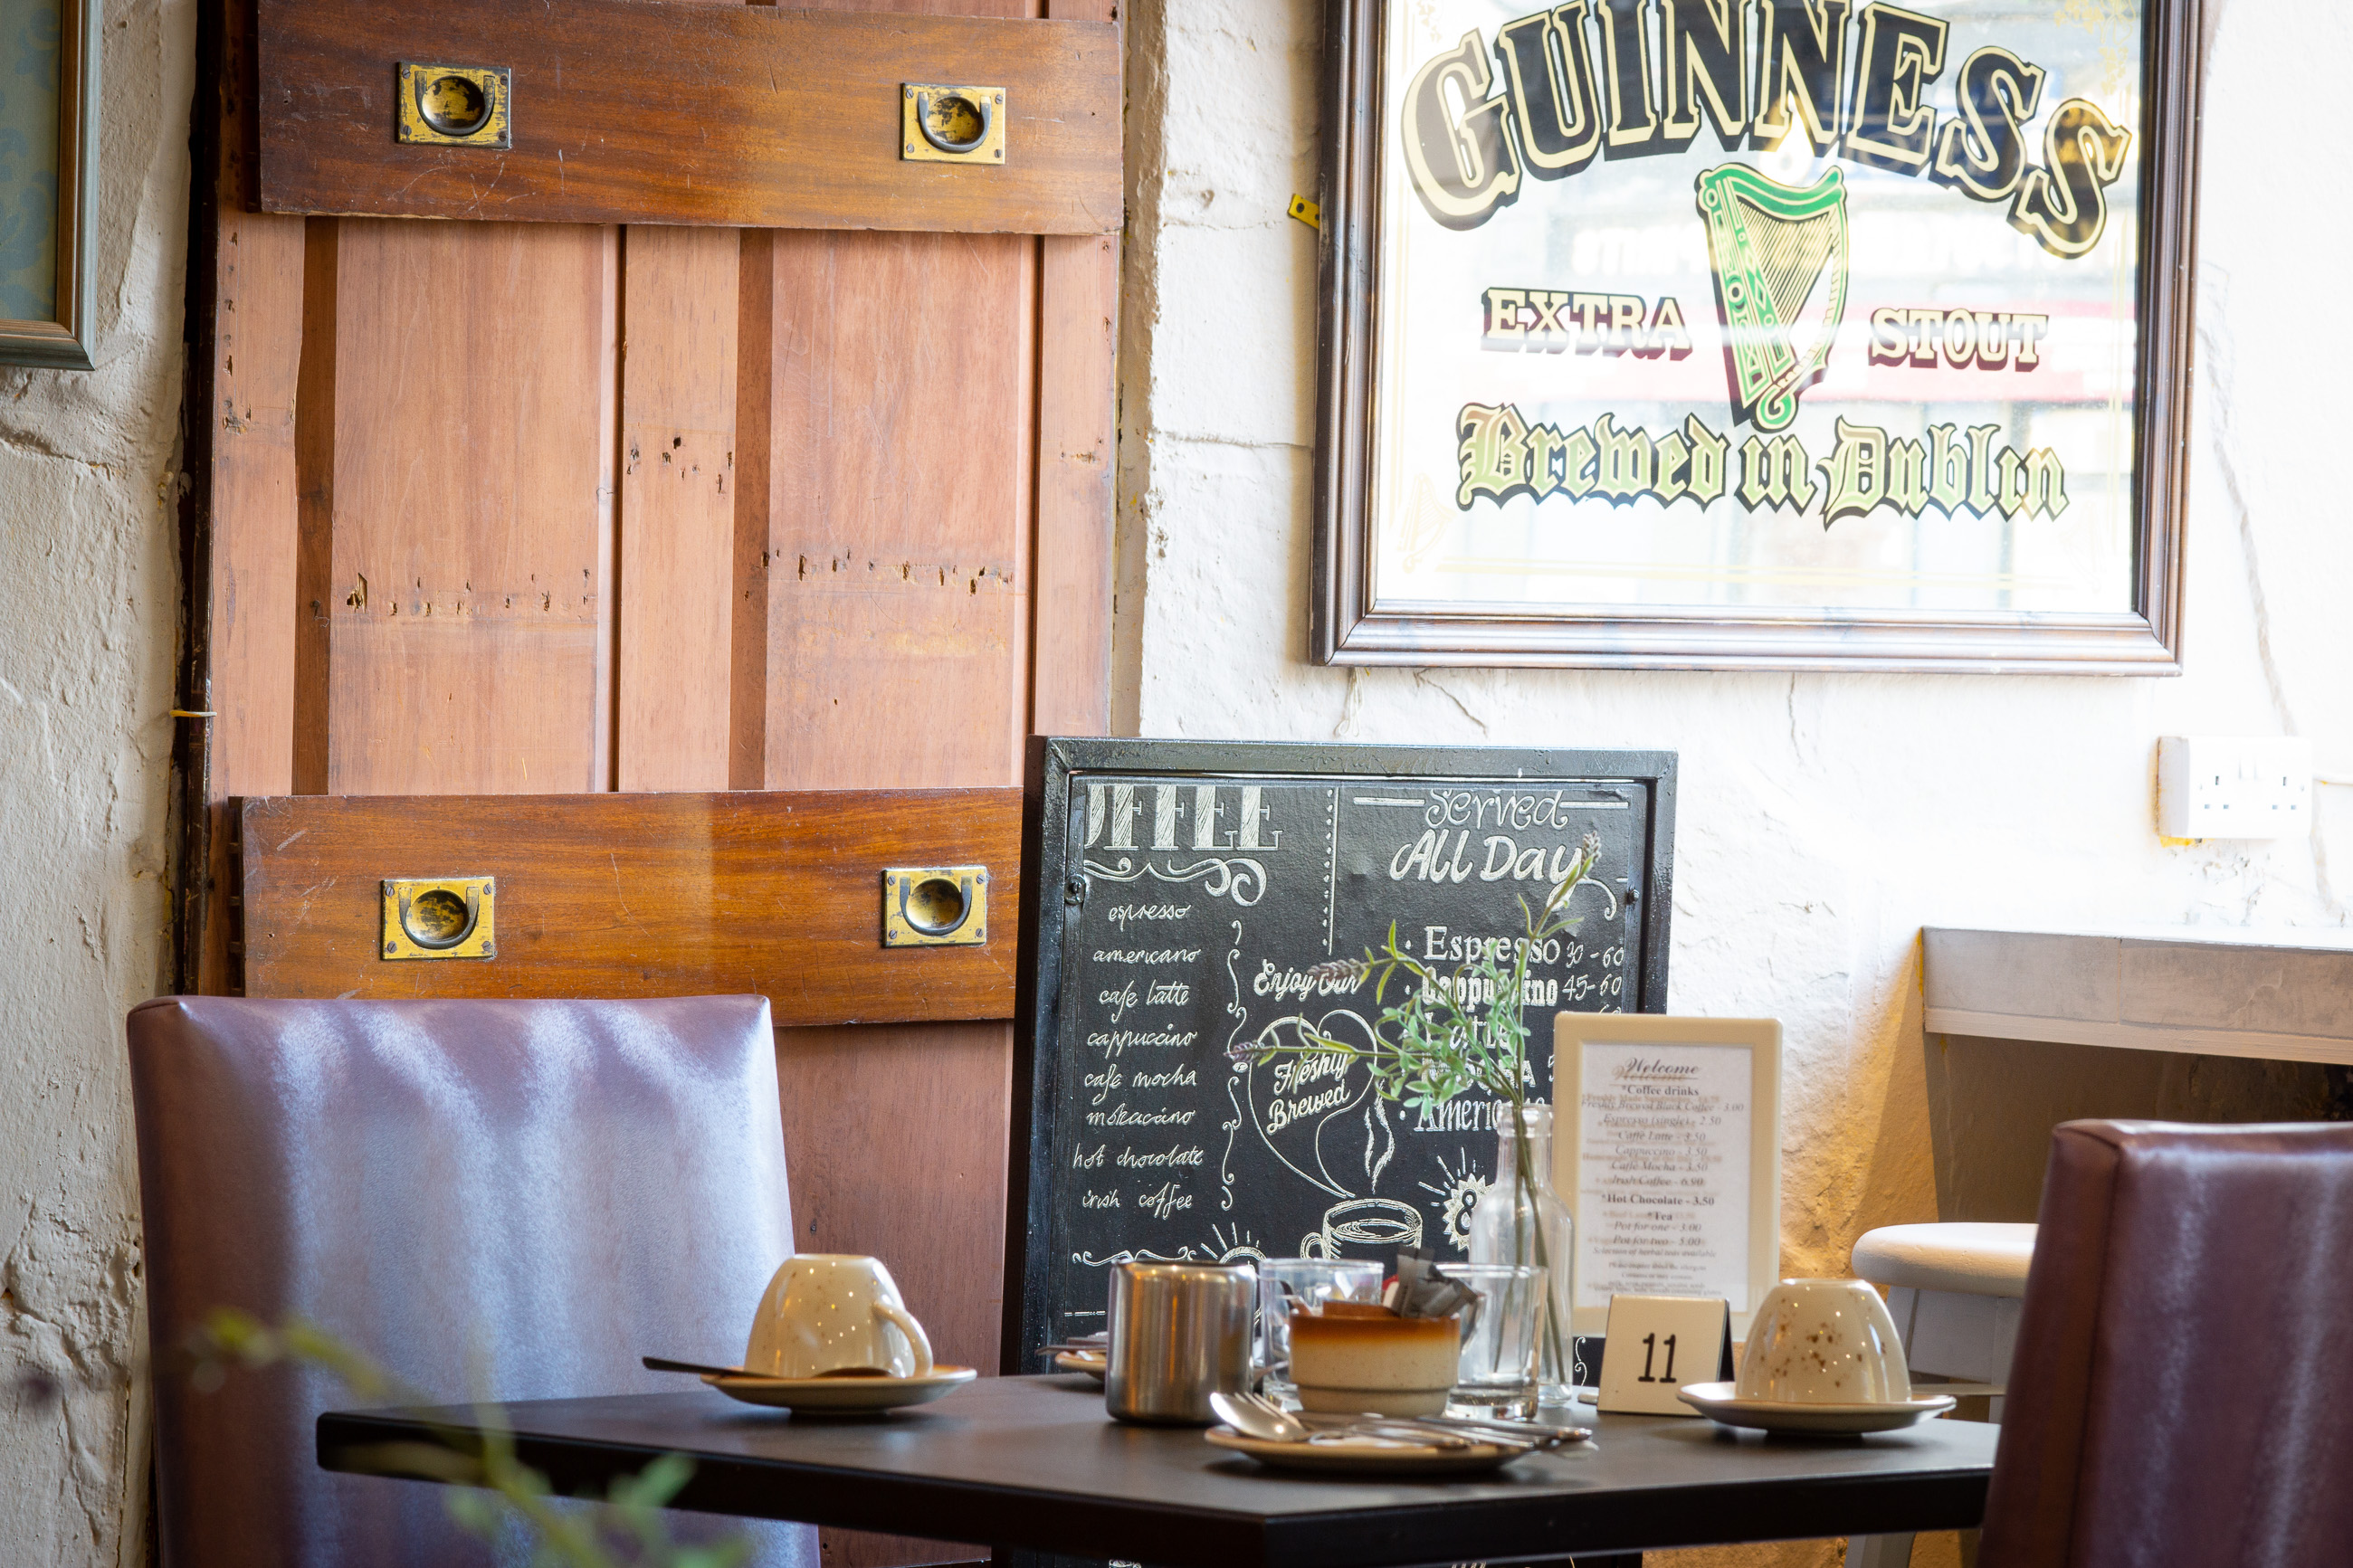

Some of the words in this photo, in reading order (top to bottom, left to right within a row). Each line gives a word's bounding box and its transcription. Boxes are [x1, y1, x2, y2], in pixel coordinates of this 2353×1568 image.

[1401, 0, 2132, 259] GUINNESS
[1481, 286, 1693, 360] EXTRA
[1869, 308, 2049, 372] STOUT
[1455, 402, 1730, 512] Brewed
[1732, 432, 1818, 515] in
[1815, 414, 2070, 532] Dublin
[1424, 787, 1569, 830] Served
[1389, 828, 1472, 884] All
[1479, 835, 1617, 921] Day
[1108, 904, 1192, 933] espresso
[1092, 948, 1202, 964] americano
[1424, 926, 1562, 971] Espresso
[1099, 980, 1138, 1024] cafe
[1146, 979, 1192, 1006] latte
[1253, 959, 1317, 1003] Enjoy
[1087, 1023, 1198, 1060] cappuccino
[1084, 1063, 1122, 1106] cafe
[1132, 1063, 1197, 1088] mocha
[1626, 1057, 1700, 1074] Welcome
[1267, 1079, 1351, 1136] Brewed
[1664, 1085, 1700, 1096] drinks
[1073, 1143, 1106, 1170] hot
[1117, 1145, 1205, 1170] chocolate
[1082, 1189, 1121, 1209] irish
[1138, 1182, 1193, 1220] coffee
[1630, 1193, 1683, 1205] Chocolate
[1692, 1195, 1716, 1206] 3.50
[1638, 1332, 1677, 1383] 11
